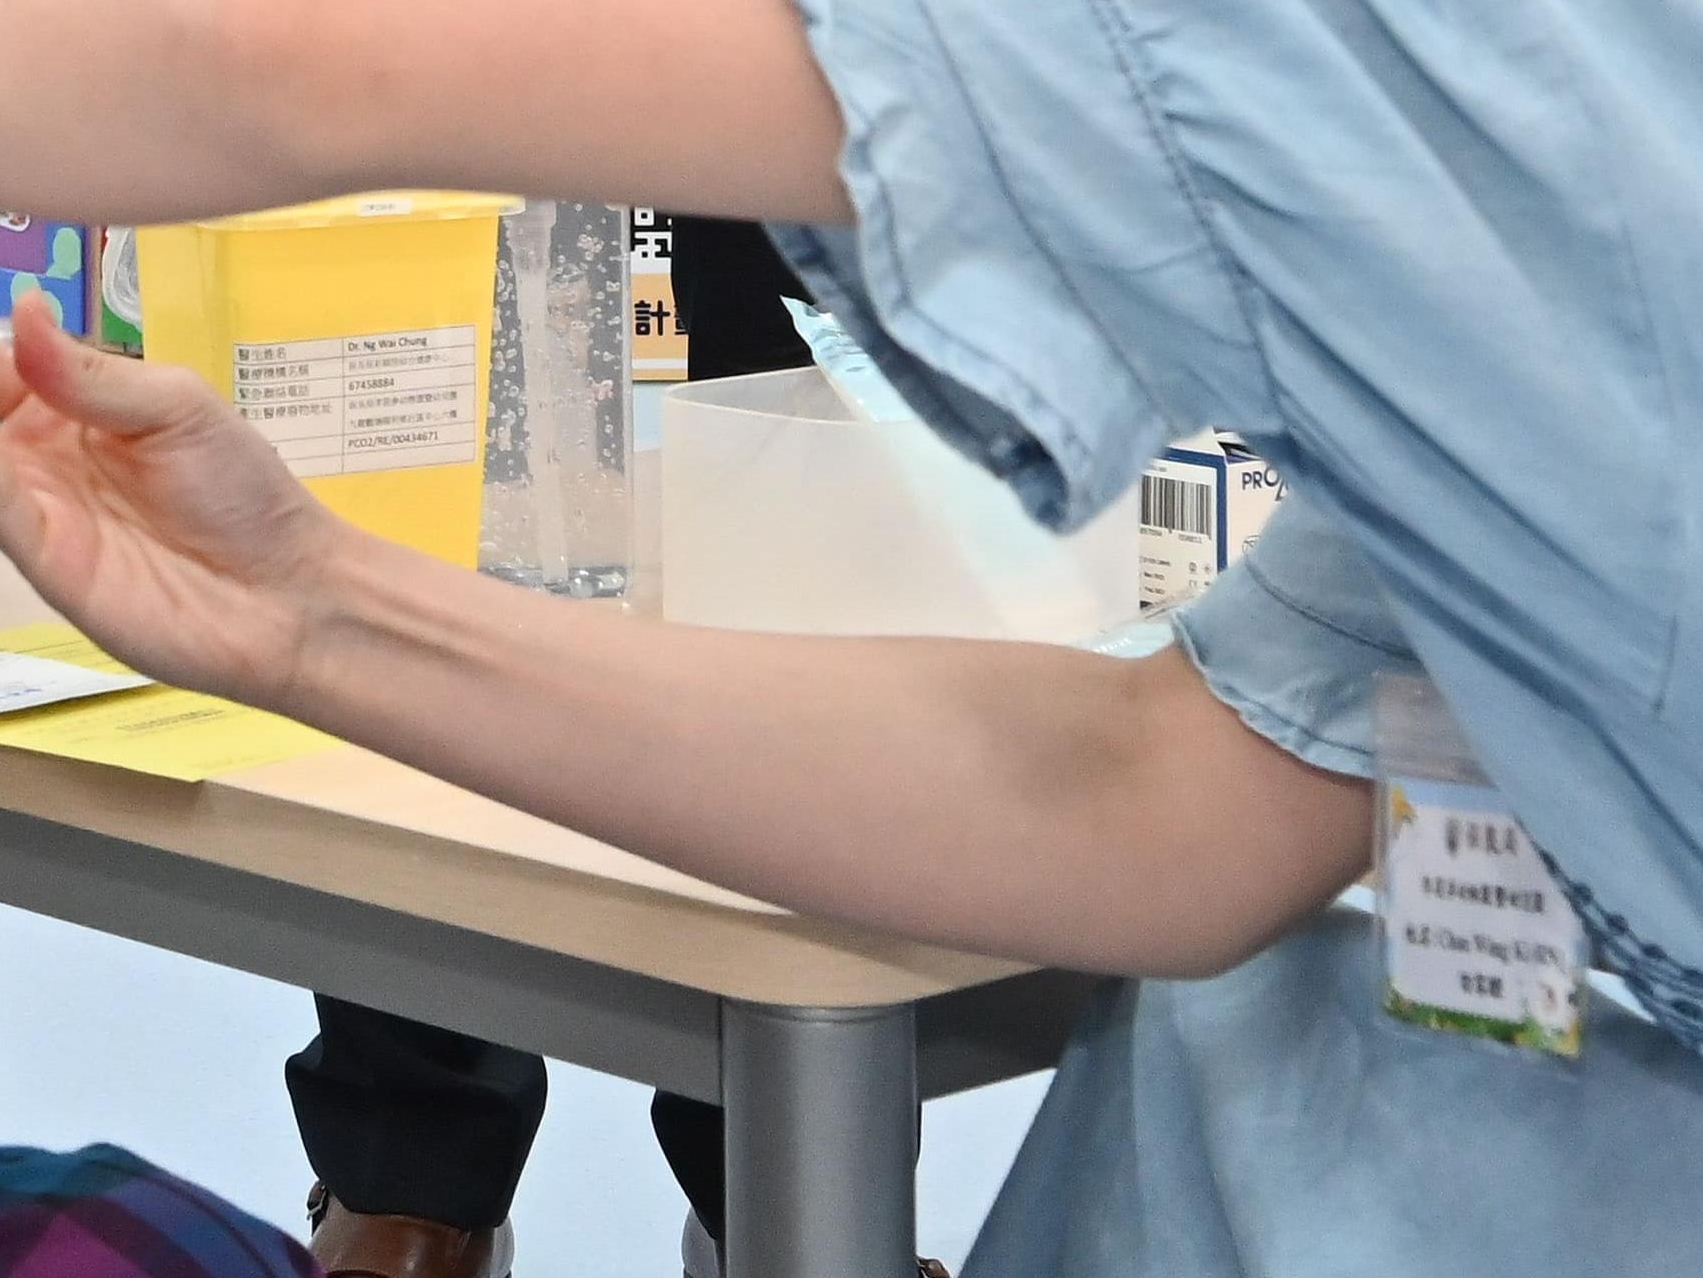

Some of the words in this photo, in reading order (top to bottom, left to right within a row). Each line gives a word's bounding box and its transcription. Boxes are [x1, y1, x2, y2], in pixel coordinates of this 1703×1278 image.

[348, 341, 361, 352] Dr.
[363, 340, 376, 352] Ng
[378, 338, 396, 349] Wai
[398, 336, 427, 348] Chung
